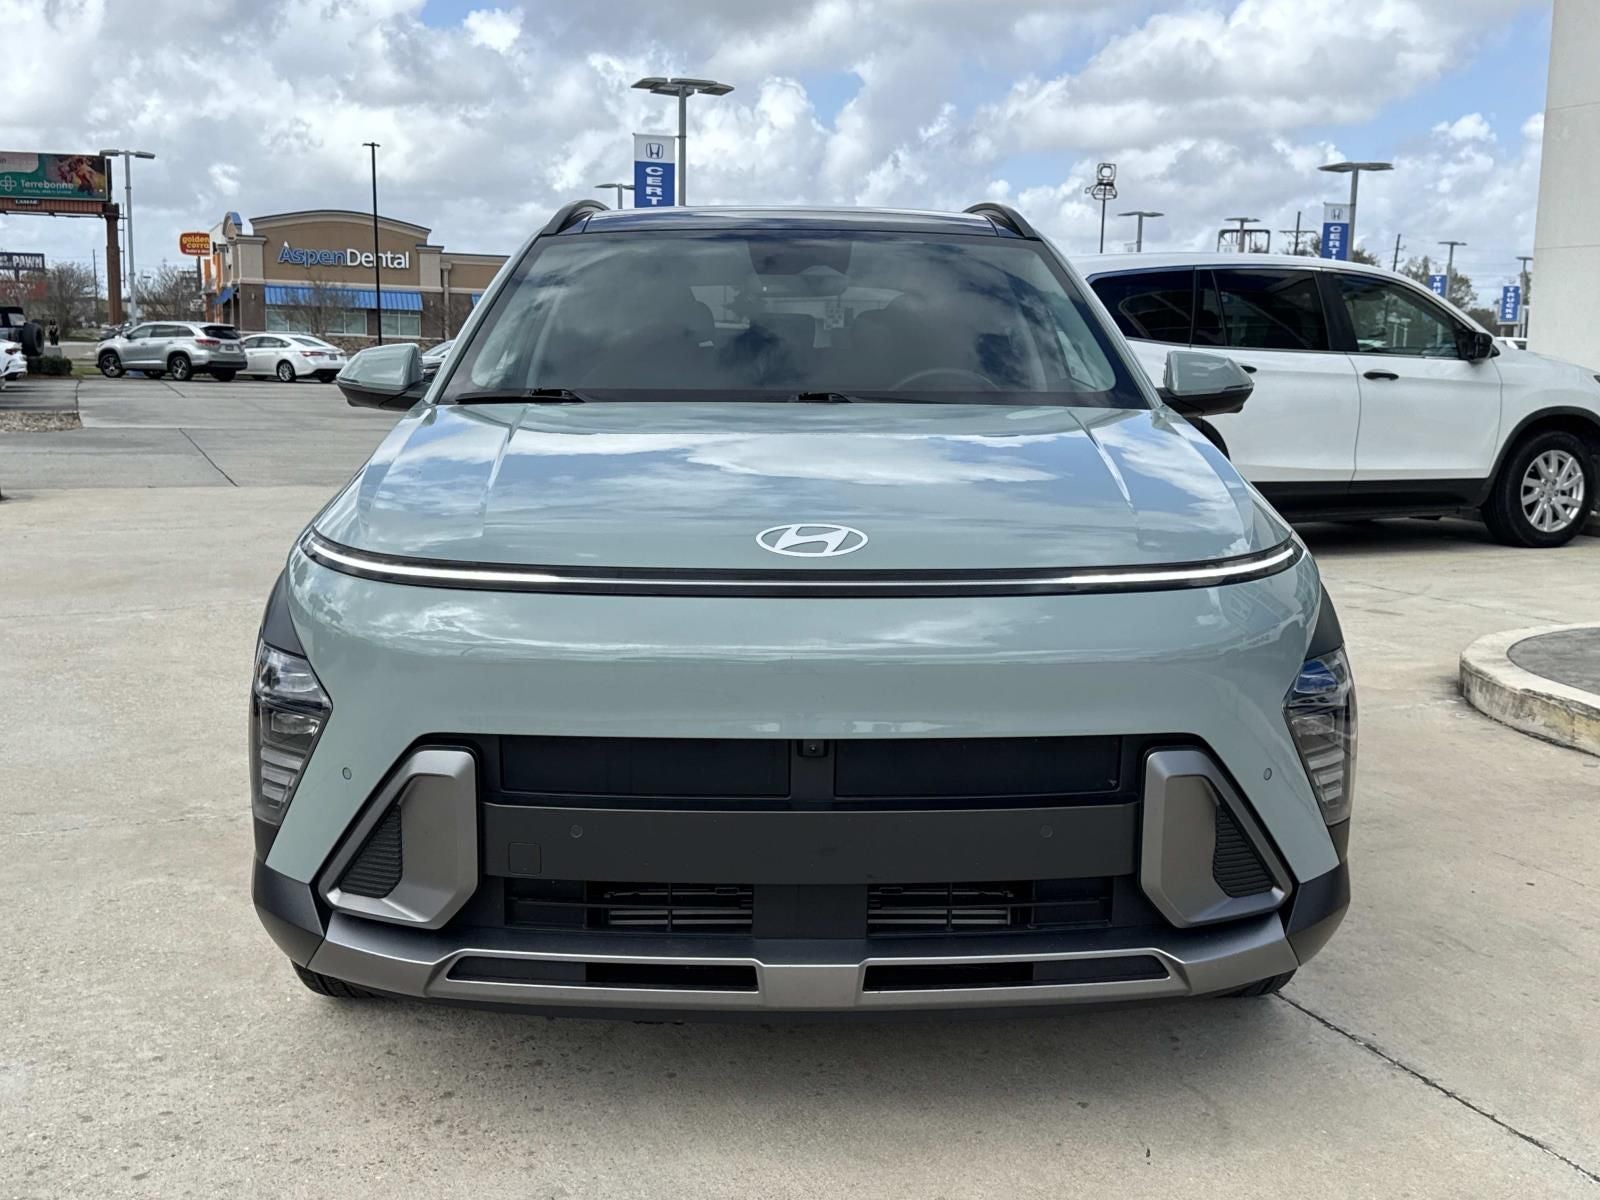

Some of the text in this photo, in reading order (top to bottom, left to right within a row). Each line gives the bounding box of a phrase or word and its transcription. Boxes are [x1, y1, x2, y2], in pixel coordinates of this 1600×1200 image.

[21, 180, 74, 190] Terrebonne
[645, 166, 664, 205] CERT
[182, 235, 210, 244] golden
[12, 255, 43, 268] PAWN
[1505, 287, 1515, 319] TRUCKS
